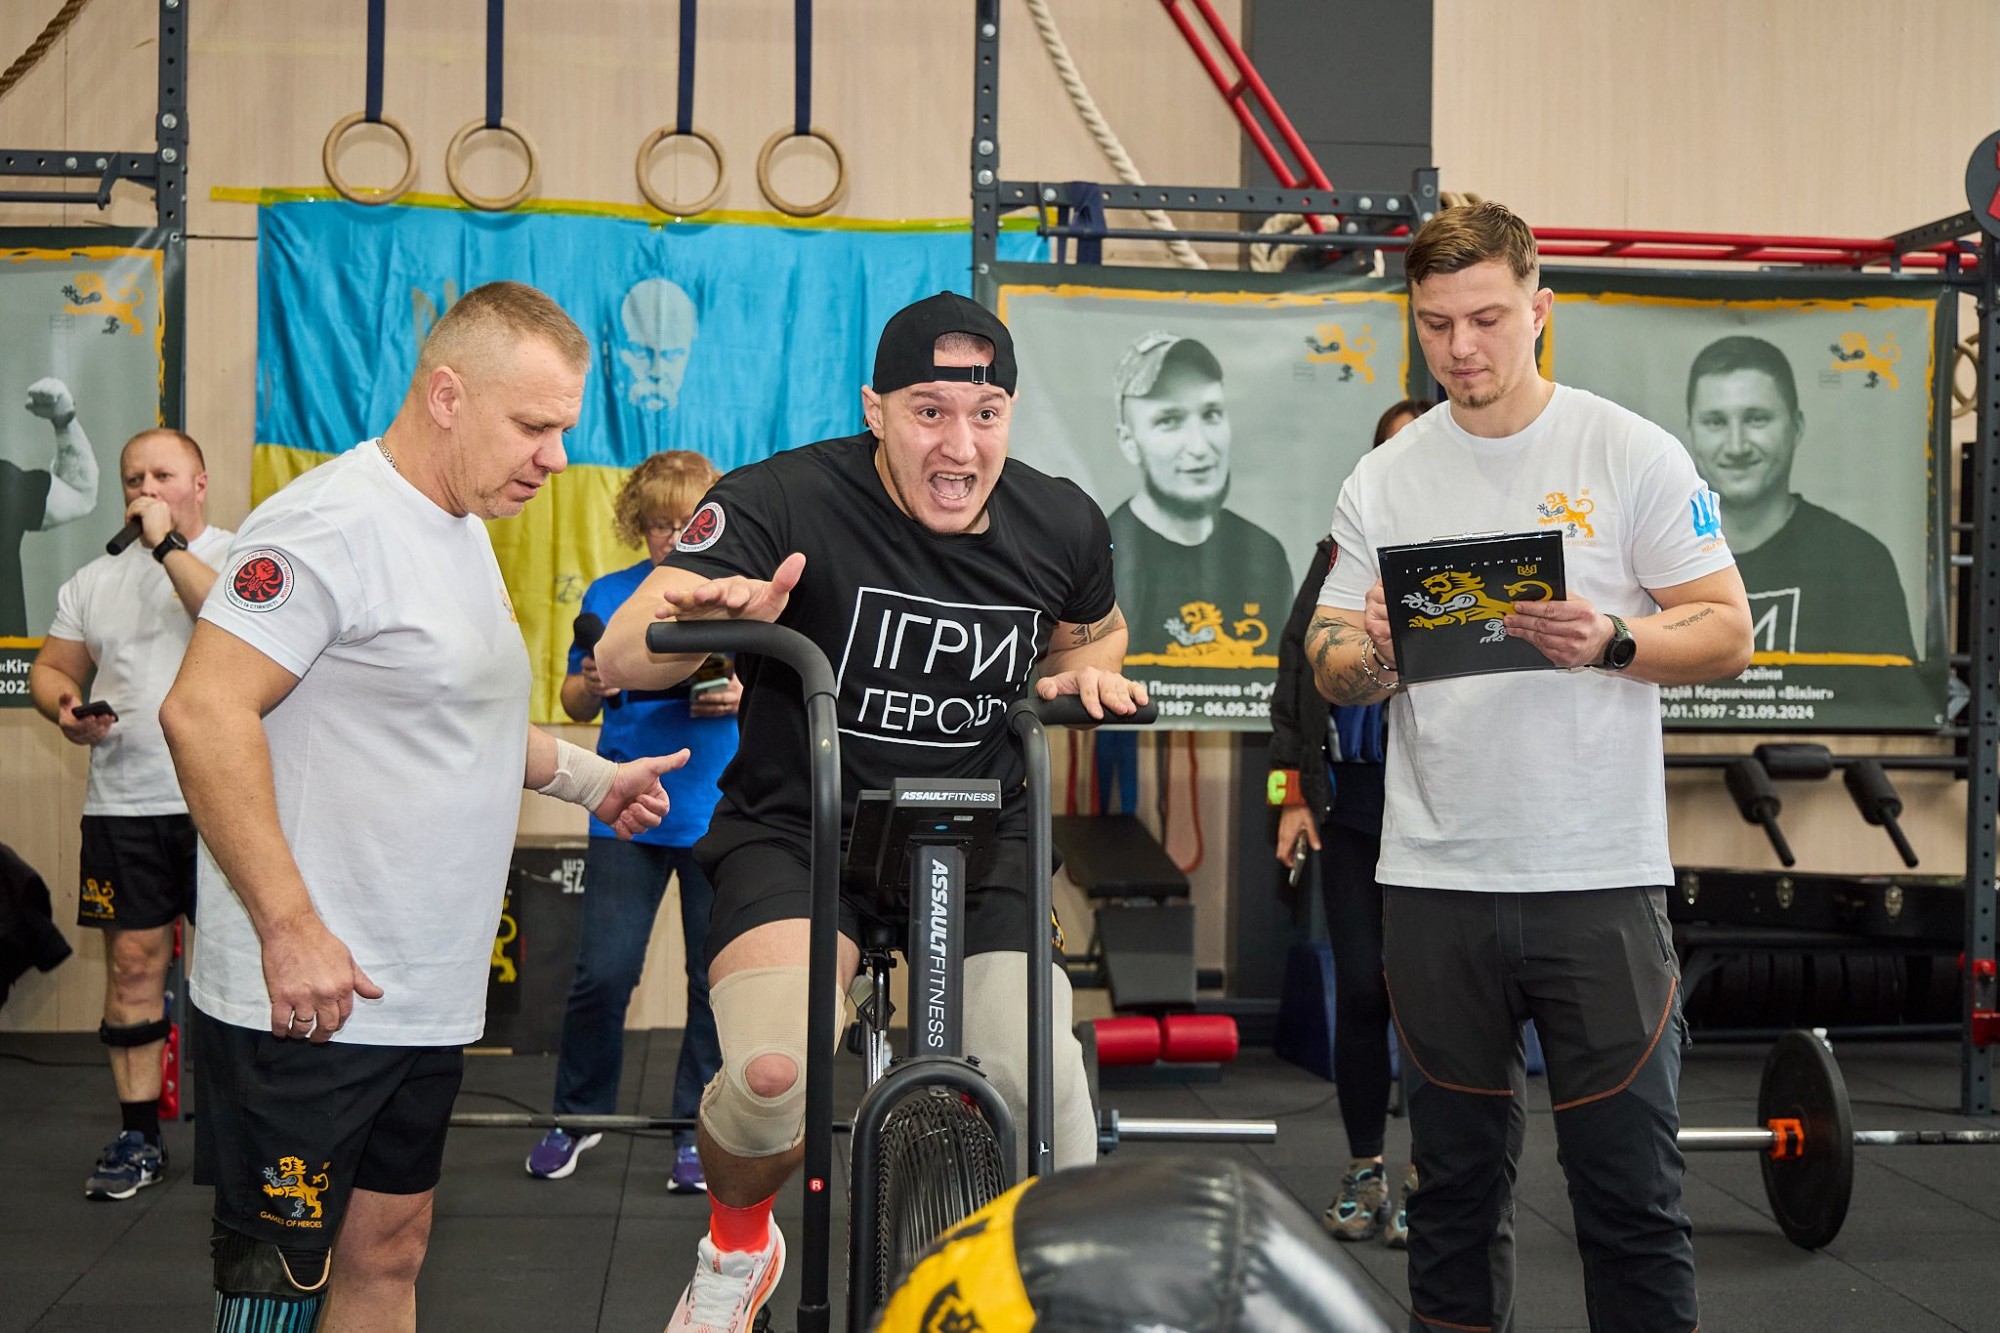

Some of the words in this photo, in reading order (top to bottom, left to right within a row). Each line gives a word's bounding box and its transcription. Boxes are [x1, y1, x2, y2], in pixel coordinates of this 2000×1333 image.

[1405, 563, 1454, 574] ІГРИ
[873, 609, 1018, 683] ІГРИ
[0, 659, 33, 674] «Кіт
[1741, 666, 1783, 683] раїни
[0, 680, 30, 694] 202
[1149, 680, 1242, 699] Петровичев
[1660, 684, 1693, 701] адій
[1777, 685, 1835, 700] «Вікінг»
[1157, 700, 1194, 716] 1987
[1736, 704, 1815, 719] 23.09.2024
[901, 791, 996, 802] ASSAULTFITNESS
[927, 858, 949, 1048] ASSAULTFITNESS
[812, 1180, 821, 1190] R
[260, 1210, 285, 1225] GAMES
[297, 1220, 323, 1228] HEROES
